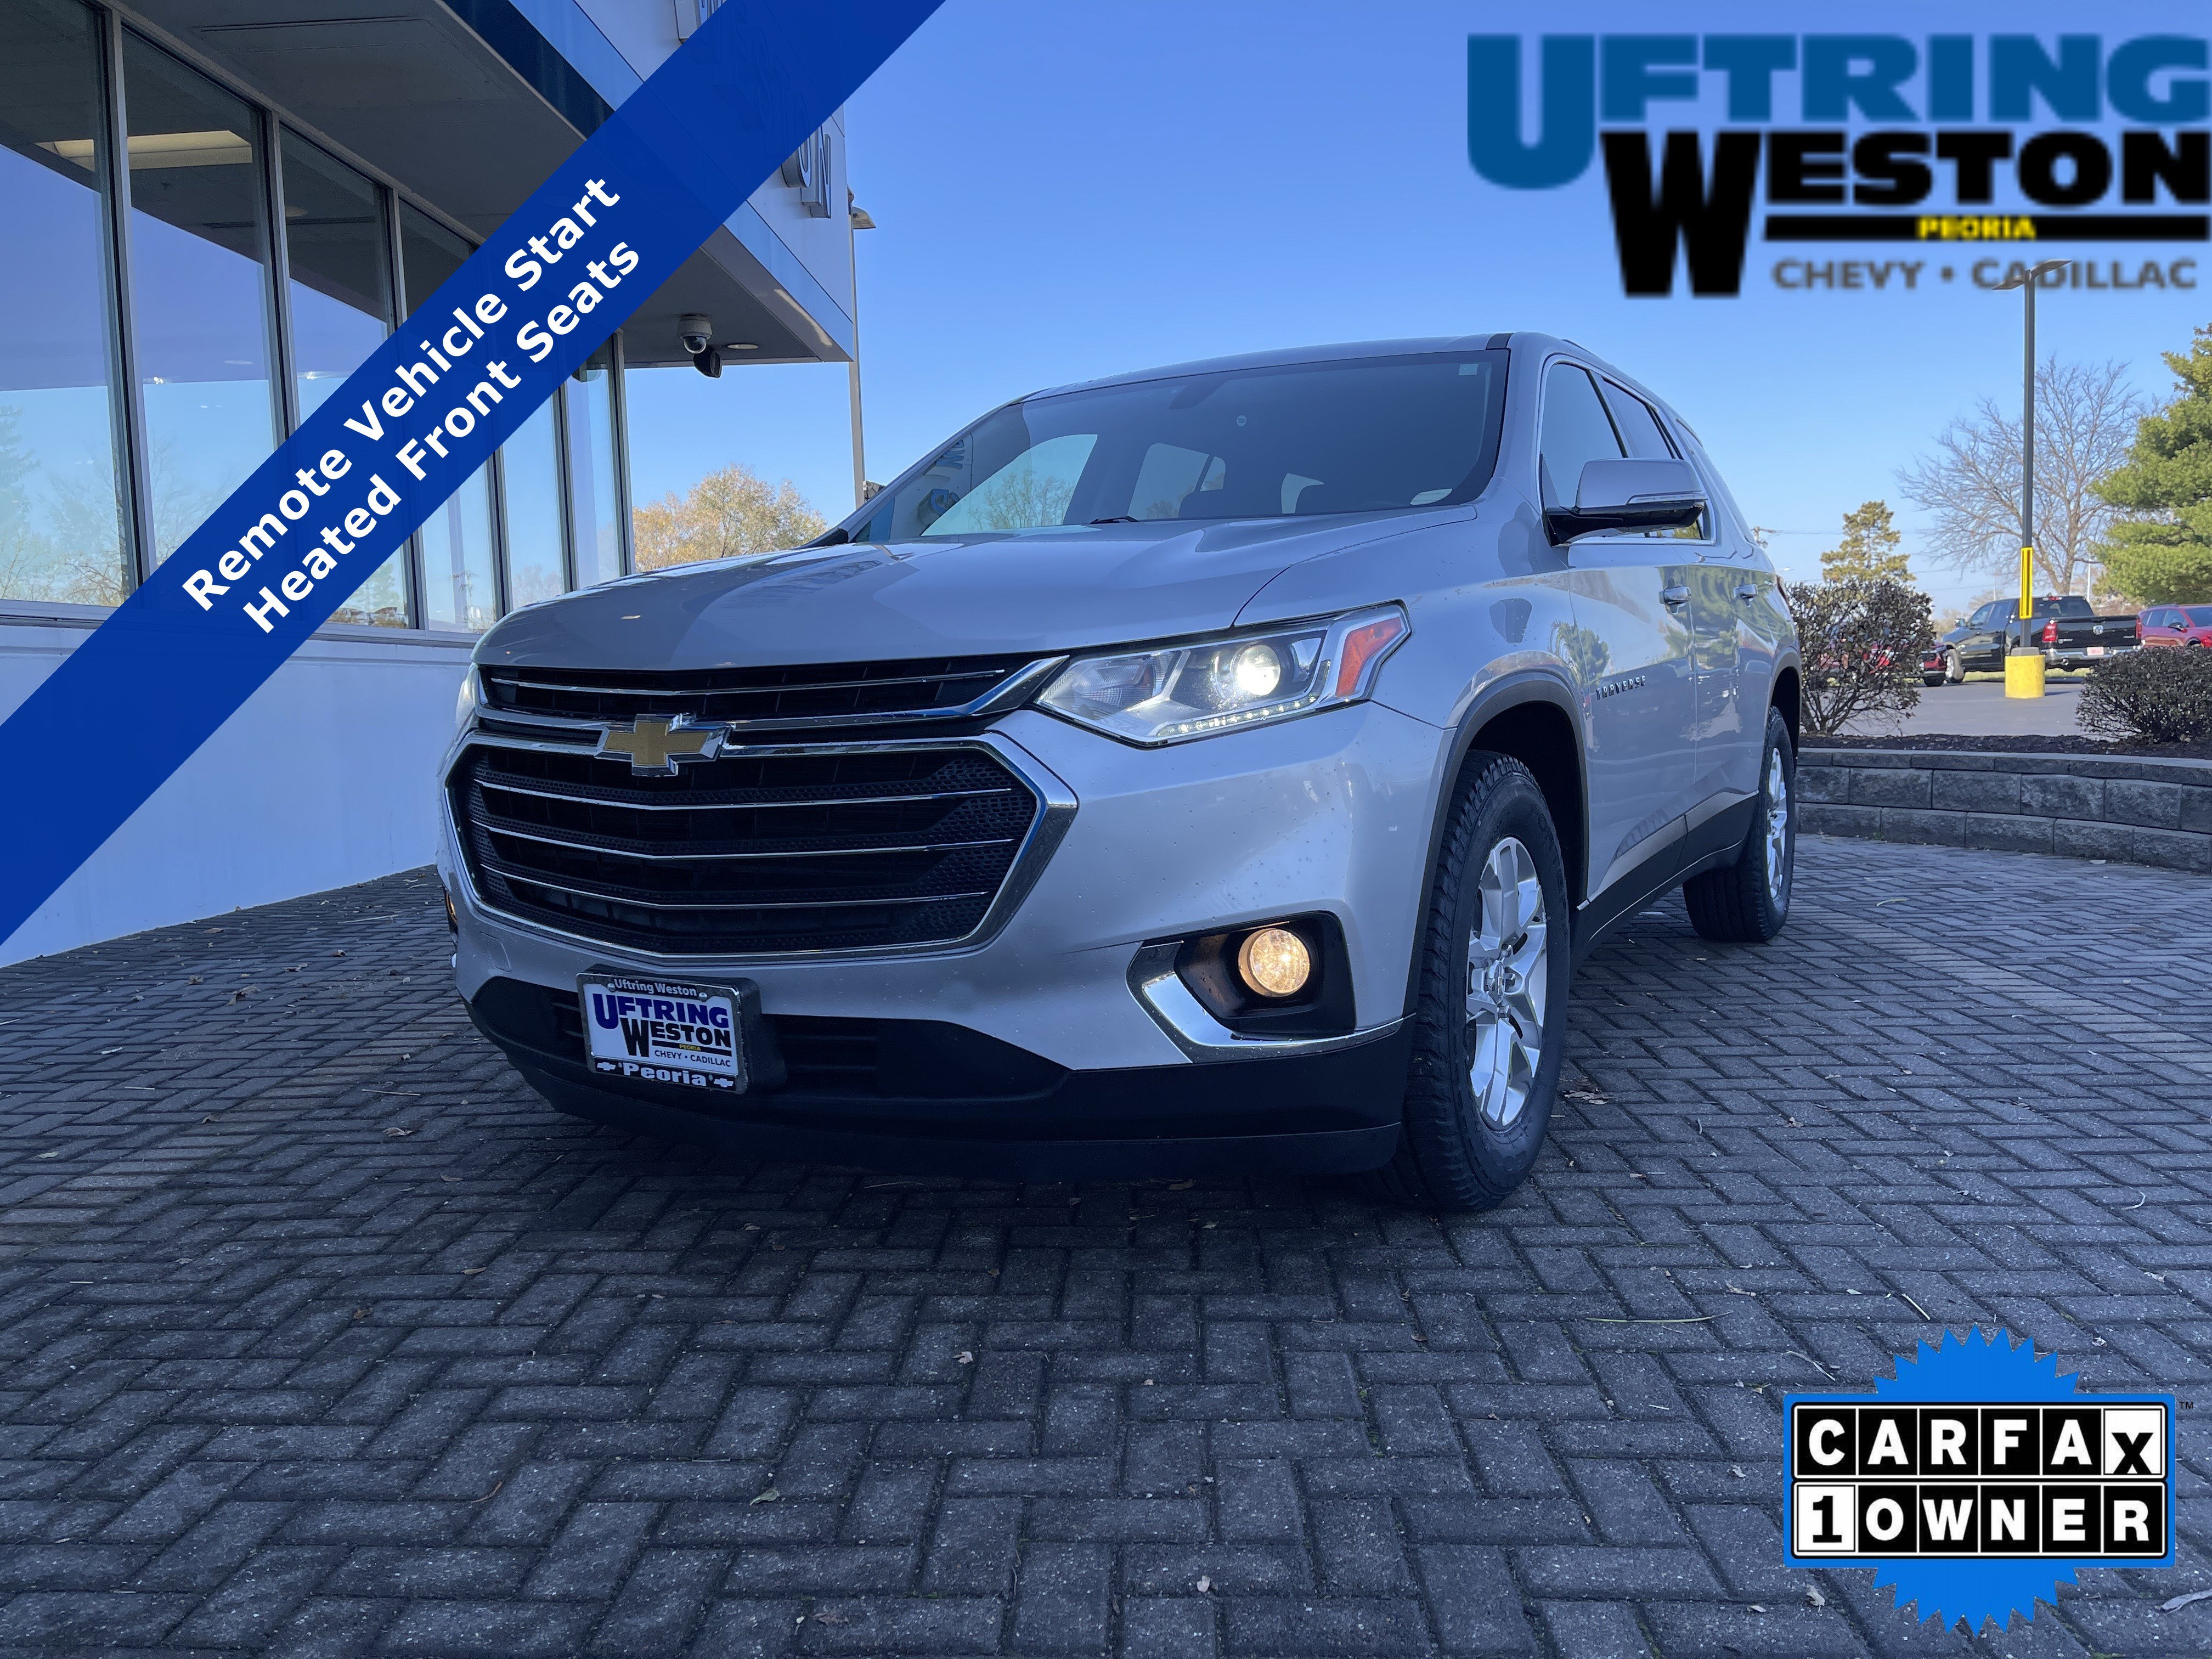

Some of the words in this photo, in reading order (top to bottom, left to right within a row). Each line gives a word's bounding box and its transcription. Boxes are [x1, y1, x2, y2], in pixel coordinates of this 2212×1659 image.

[1595, 675, 1646, 701] TRAVERSE
[614, 978, 654, 994] Uftring
[654, 983, 697, 996] Weston
[592, 993, 730, 1029] UFTRING
[620, 1017, 731, 1058] WESTON
[654, 1050, 681, 1059] CHEVY
[690, 1054, 731, 1067] CADILLAC
[622, 1062, 707, 1087] Peoria
